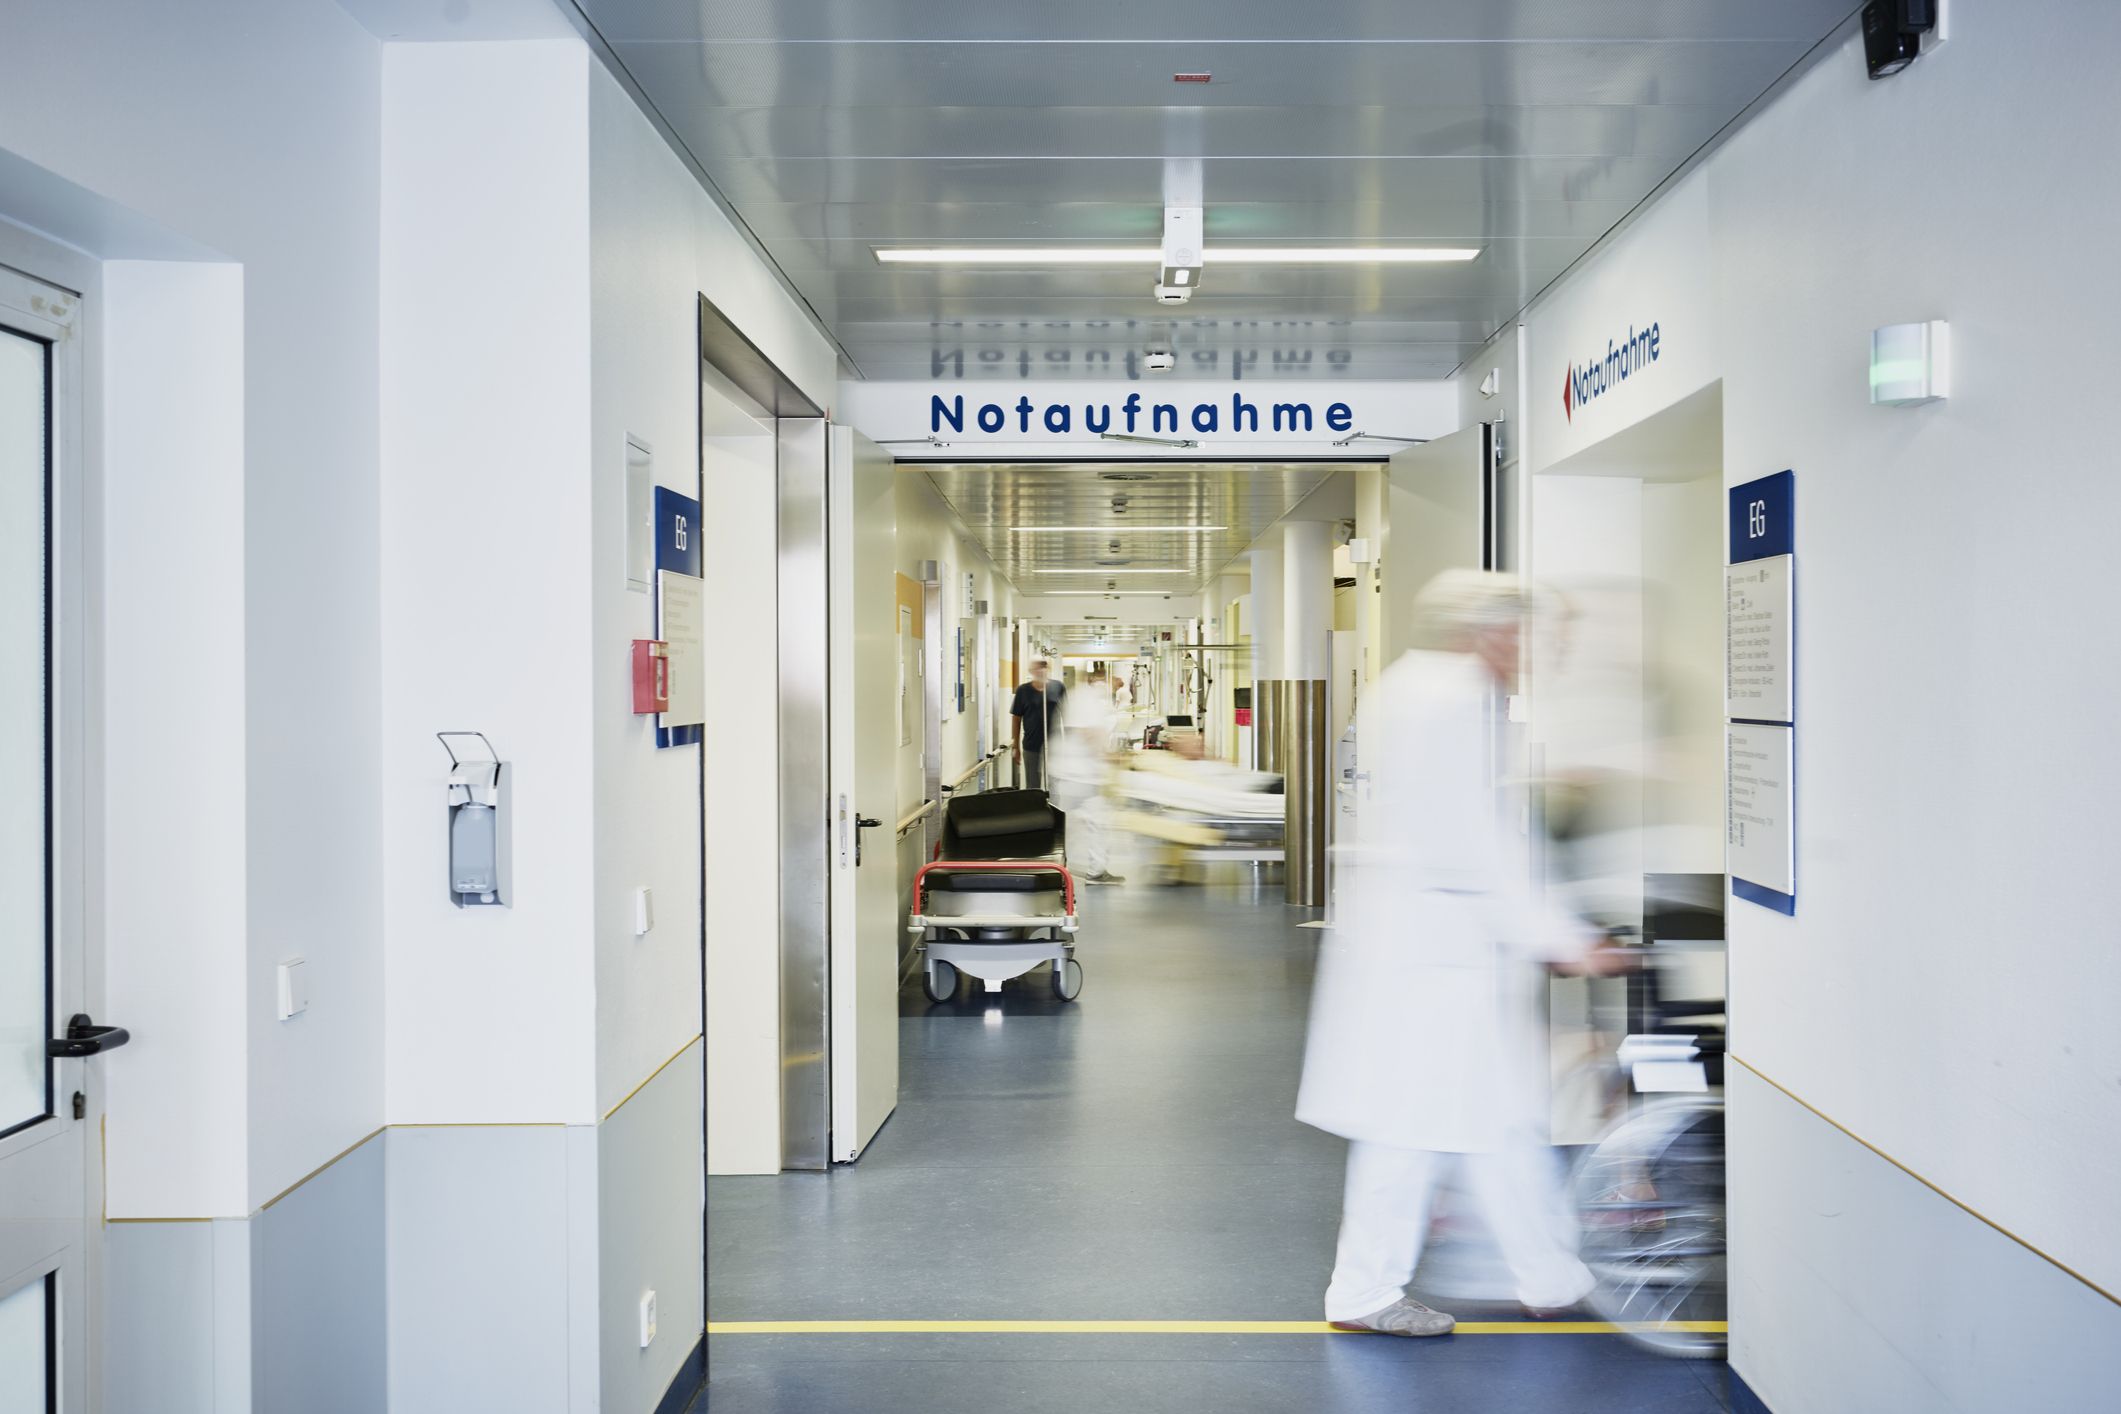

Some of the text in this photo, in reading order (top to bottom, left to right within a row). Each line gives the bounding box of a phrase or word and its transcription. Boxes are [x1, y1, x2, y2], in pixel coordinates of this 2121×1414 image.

[1572, 322, 1661, 411] Notaufnahme
[931, 392, 1353, 433] Notaufnahme
[675, 514, 687, 551] EG
[1749, 499, 1766, 539] EG
